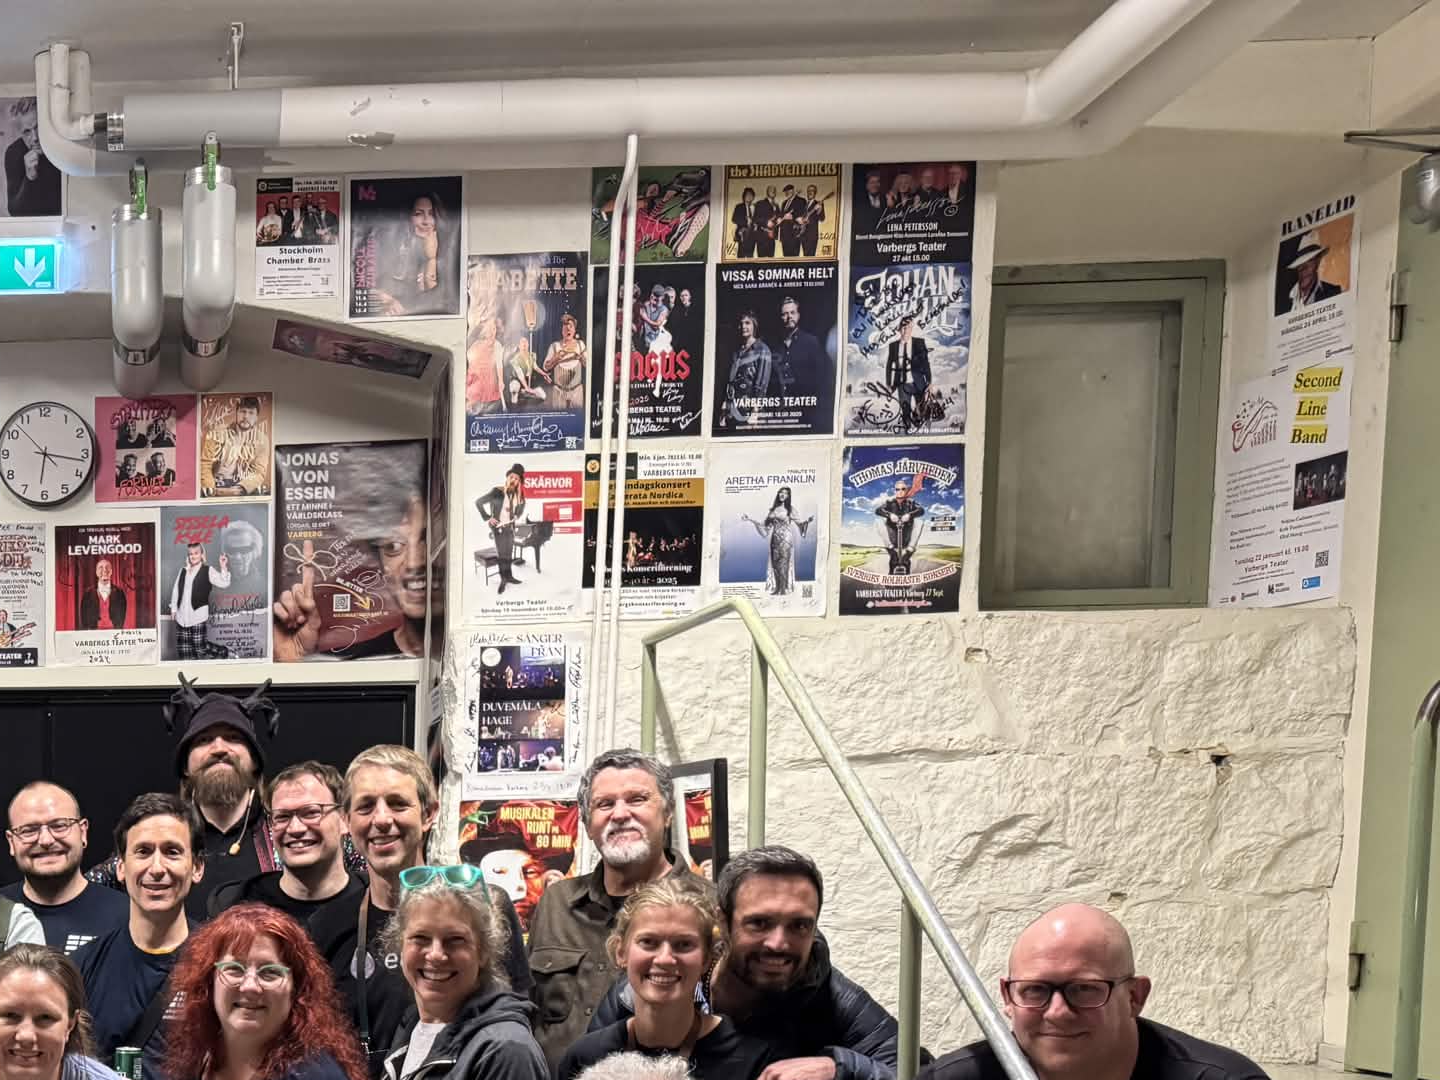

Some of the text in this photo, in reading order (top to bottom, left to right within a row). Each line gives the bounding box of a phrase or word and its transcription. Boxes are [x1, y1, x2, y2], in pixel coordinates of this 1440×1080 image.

[888, 222, 938, 232] LENA PETERSSON
[876, 242, 946, 254] Varbergs Teater
[722, 268, 834, 282] VISSA SOMNAR HELT
[1294, 370, 1342, 390] Second
[734, 396, 817, 408] VARBERGS TEATER
[39, 407, 51, 418] 12
[1296, 401, 1328, 416] Line
[21, 414, 30, 424] 11
[64, 414, 68, 424] 1
[7, 429, 20, 440] 10
[76, 428, 84, 439] 2
[1290, 428, 1328, 445] Band
[1, 449, 10, 460] 9
[81, 448, 89, 460] 3
[282, 452, 340, 466] JONAS
[6, 470, 15, 480] 8
[75, 468, 83, 480] 4
[292, 470, 328, 484] VON
[851, 459, 956, 487] THOMAS JÄRVHEDEN
[725, 475, 816, 485] ARETHA FRANKLIN
[22, 484, 29, 495] 7
[40, 490, 48, 501] 6
[61, 484, 69, 495] 5
[286, 486, 336, 500] ESSEN
[650, 492, 684, 500] Nordica
[88, 535, 120, 544] MARK
[68, 544, 142, 556] LEVENGOOD
[482, 700, 542, 712] DUVEMÅLA
[482, 716, 513, 726] HAGE
[501, 807, 555, 820] MUSIKALEN
[526, 822, 552, 834] RUNT
[536, 835, 572, 848] 80 MIN
